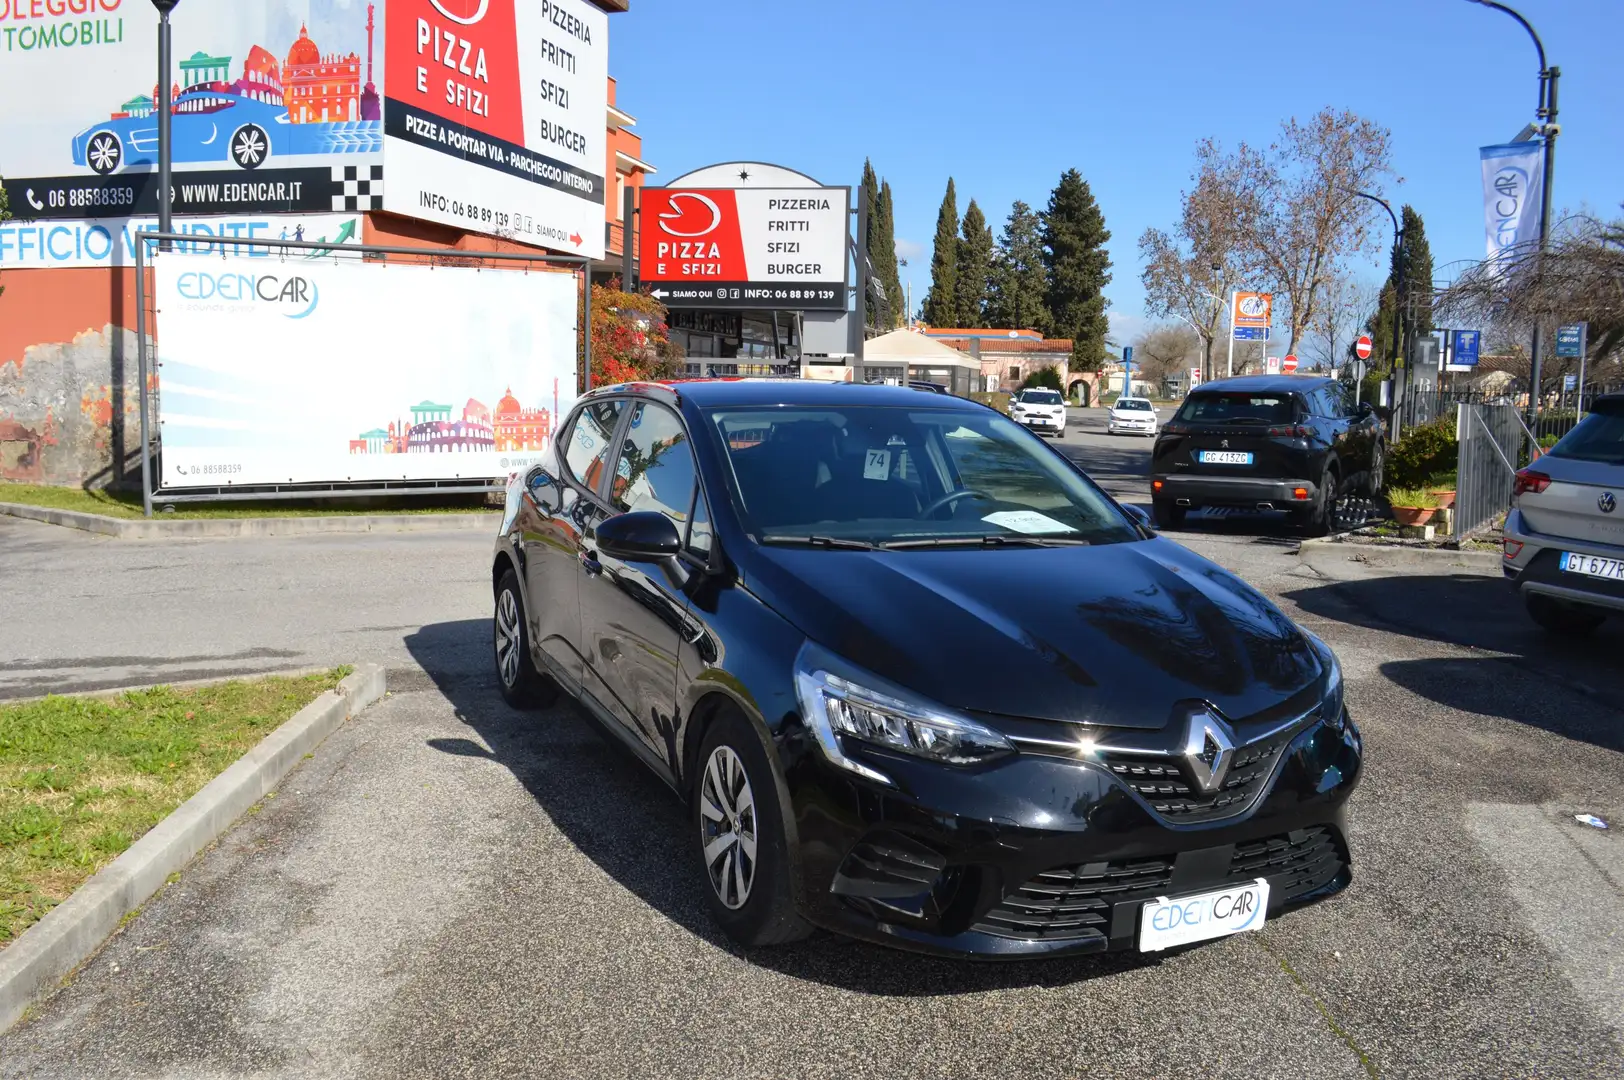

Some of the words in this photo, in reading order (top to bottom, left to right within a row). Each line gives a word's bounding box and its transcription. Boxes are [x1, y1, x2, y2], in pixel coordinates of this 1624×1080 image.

[541, 0, 592, 45] PIZZERIA
[416, 17, 489, 84] PIZZA
[541, 38, 576, 75] FRITTI
[416, 66, 428, 94] E
[446, 79, 489, 117] SFIZI
[540, 78, 569, 110] SFIZI
[540, 118, 586, 155] BURGER
[405, 114, 437, 140] PIZZE
[438, 126, 446, 144] A
[448, 129, 487, 158] PORTAR
[488, 144, 504, 164] VIA
[510, 152, 562, 183] PARCHEGGIO
[562, 170, 593, 194] INTERNO
[49, 189, 65, 208] 06
[69, 186, 134, 207] 88588359
[181, 181, 302, 204] WWW.EDENCAR.IT
[768, 199, 830, 210] PIZZERIA
[419, 190, 449, 212] INFO:
[452, 200, 464, 216] 06
[467, 204, 479, 220] 88
[481, 207, 492, 223] 89
[494, 211, 509, 227] 139
[536, 226, 556, 239] SIAMO
[556, 230, 568, 243] QUI
[768, 221, 810, 231] FRITTI
[122, 222, 269, 259] VENDITE
[657, 242, 721, 259] PIZZA
[767, 242, 800, 253] SFIZI
[656, 263, 666, 275] E
[682, 263, 721, 275] SFIZI
[767, 264, 822, 275] BURGER
[177, 272, 309, 303] EDENCAR
[672, 290, 697, 298] SIAMO
[698, 290, 713, 299] QUI
[744, 289, 772, 298] INFO:
[775, 290, 787, 299] 06
[789, 290, 801, 299] 88
[804, 290, 816, 299] 89
[818, 291, 834, 299] 139
[869, 452, 884, 467] 74
[1205, 452, 1216, 462] GG
[1219, 453, 1247, 463] 413ZG
[190, 465, 200, 475] 06
[203, 464, 242, 475] 88588359
[1568, 554, 1586, 571] GT
[1590, 558, 1624, 579] 677R
[1152, 890, 1254, 932] EDENCAR
